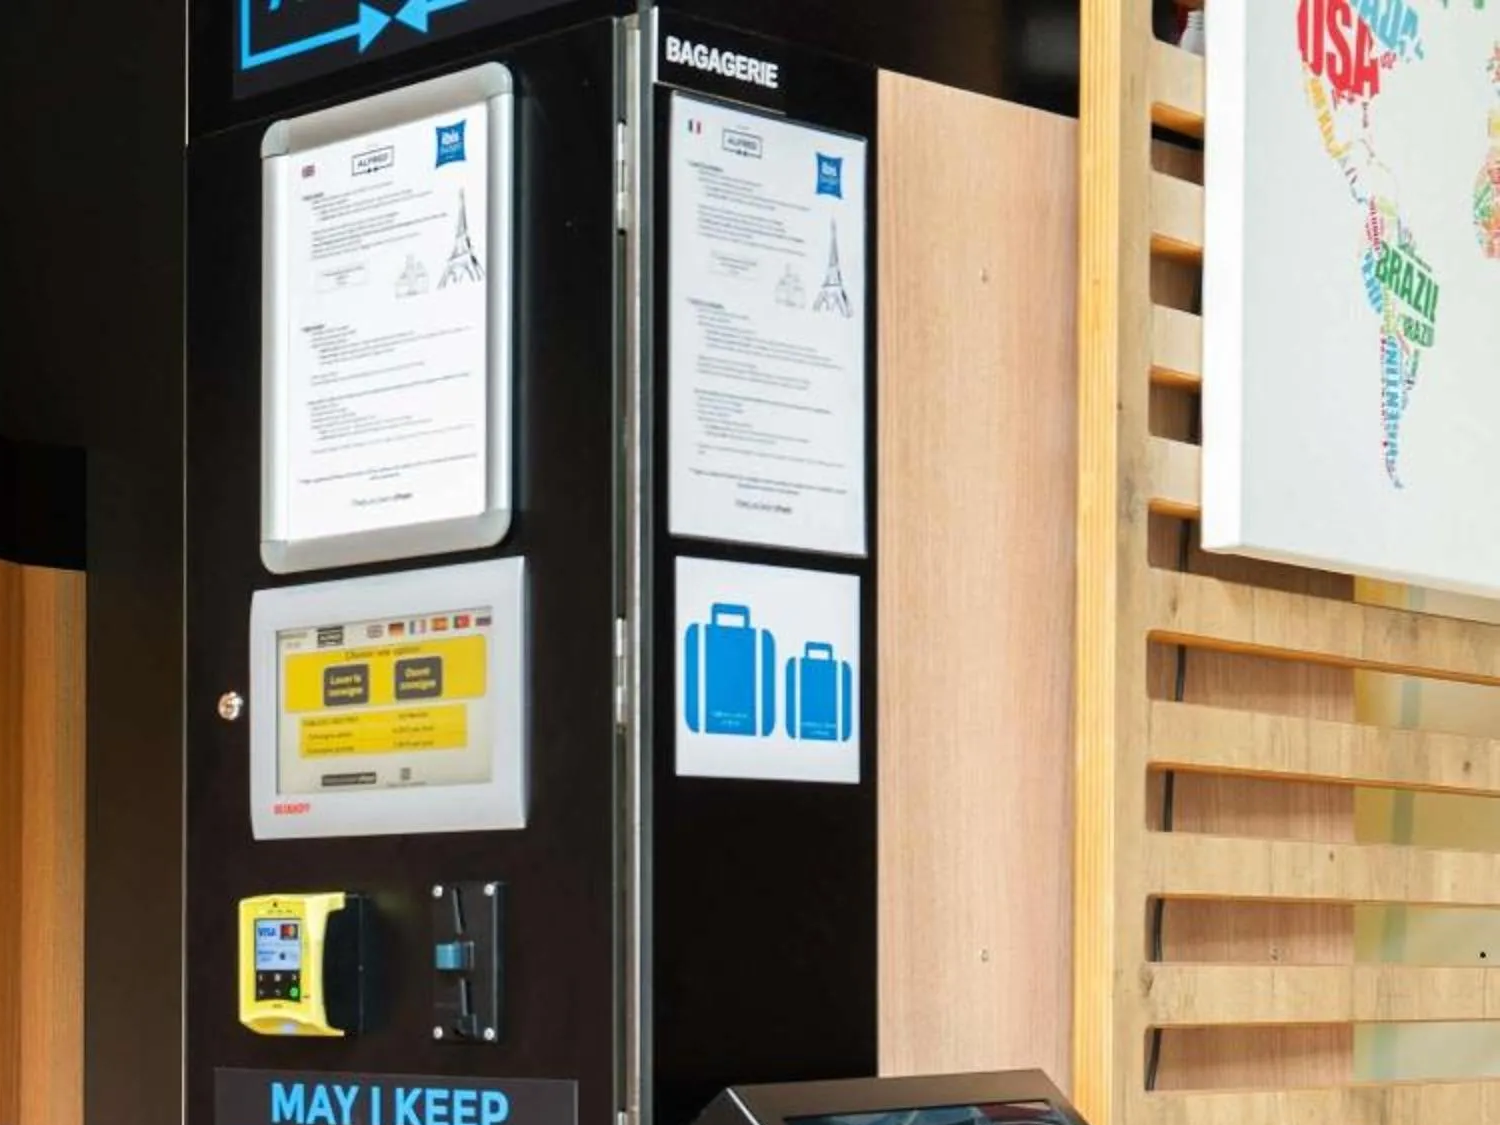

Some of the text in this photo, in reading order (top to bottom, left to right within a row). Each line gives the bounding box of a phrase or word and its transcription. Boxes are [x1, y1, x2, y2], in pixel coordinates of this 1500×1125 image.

[666, 35, 779, 88] BAGAGERIE
[1298, 0, 1380, 98] USA
[1375, 240, 1439, 324] BRAZIL
